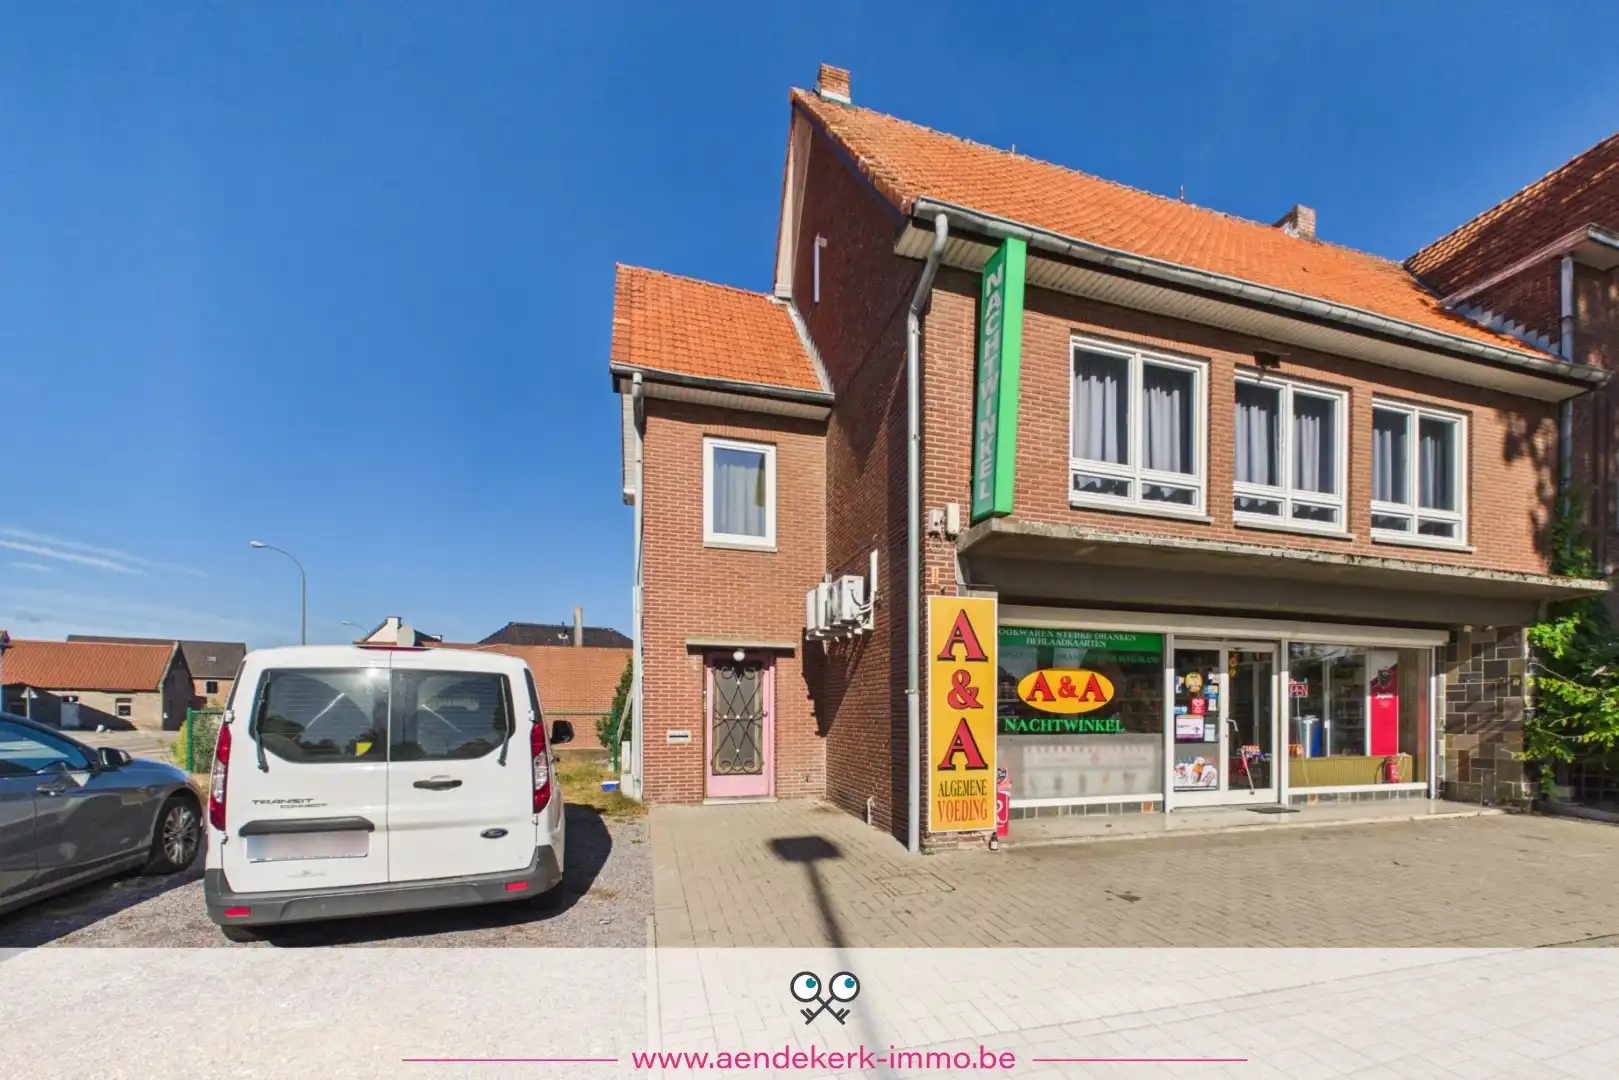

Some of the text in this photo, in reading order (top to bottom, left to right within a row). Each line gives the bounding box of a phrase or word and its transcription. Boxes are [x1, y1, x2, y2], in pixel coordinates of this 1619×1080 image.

[979, 263, 1003, 500] NACHTWINKEL
[998, 628, 1053, 638] OOKWAREN
[1004, 718, 1124, 732] NACHTWINKEL
[937, 779, 988, 798] ALGEMENE
[937, 799, 988, 823] VOEDING
